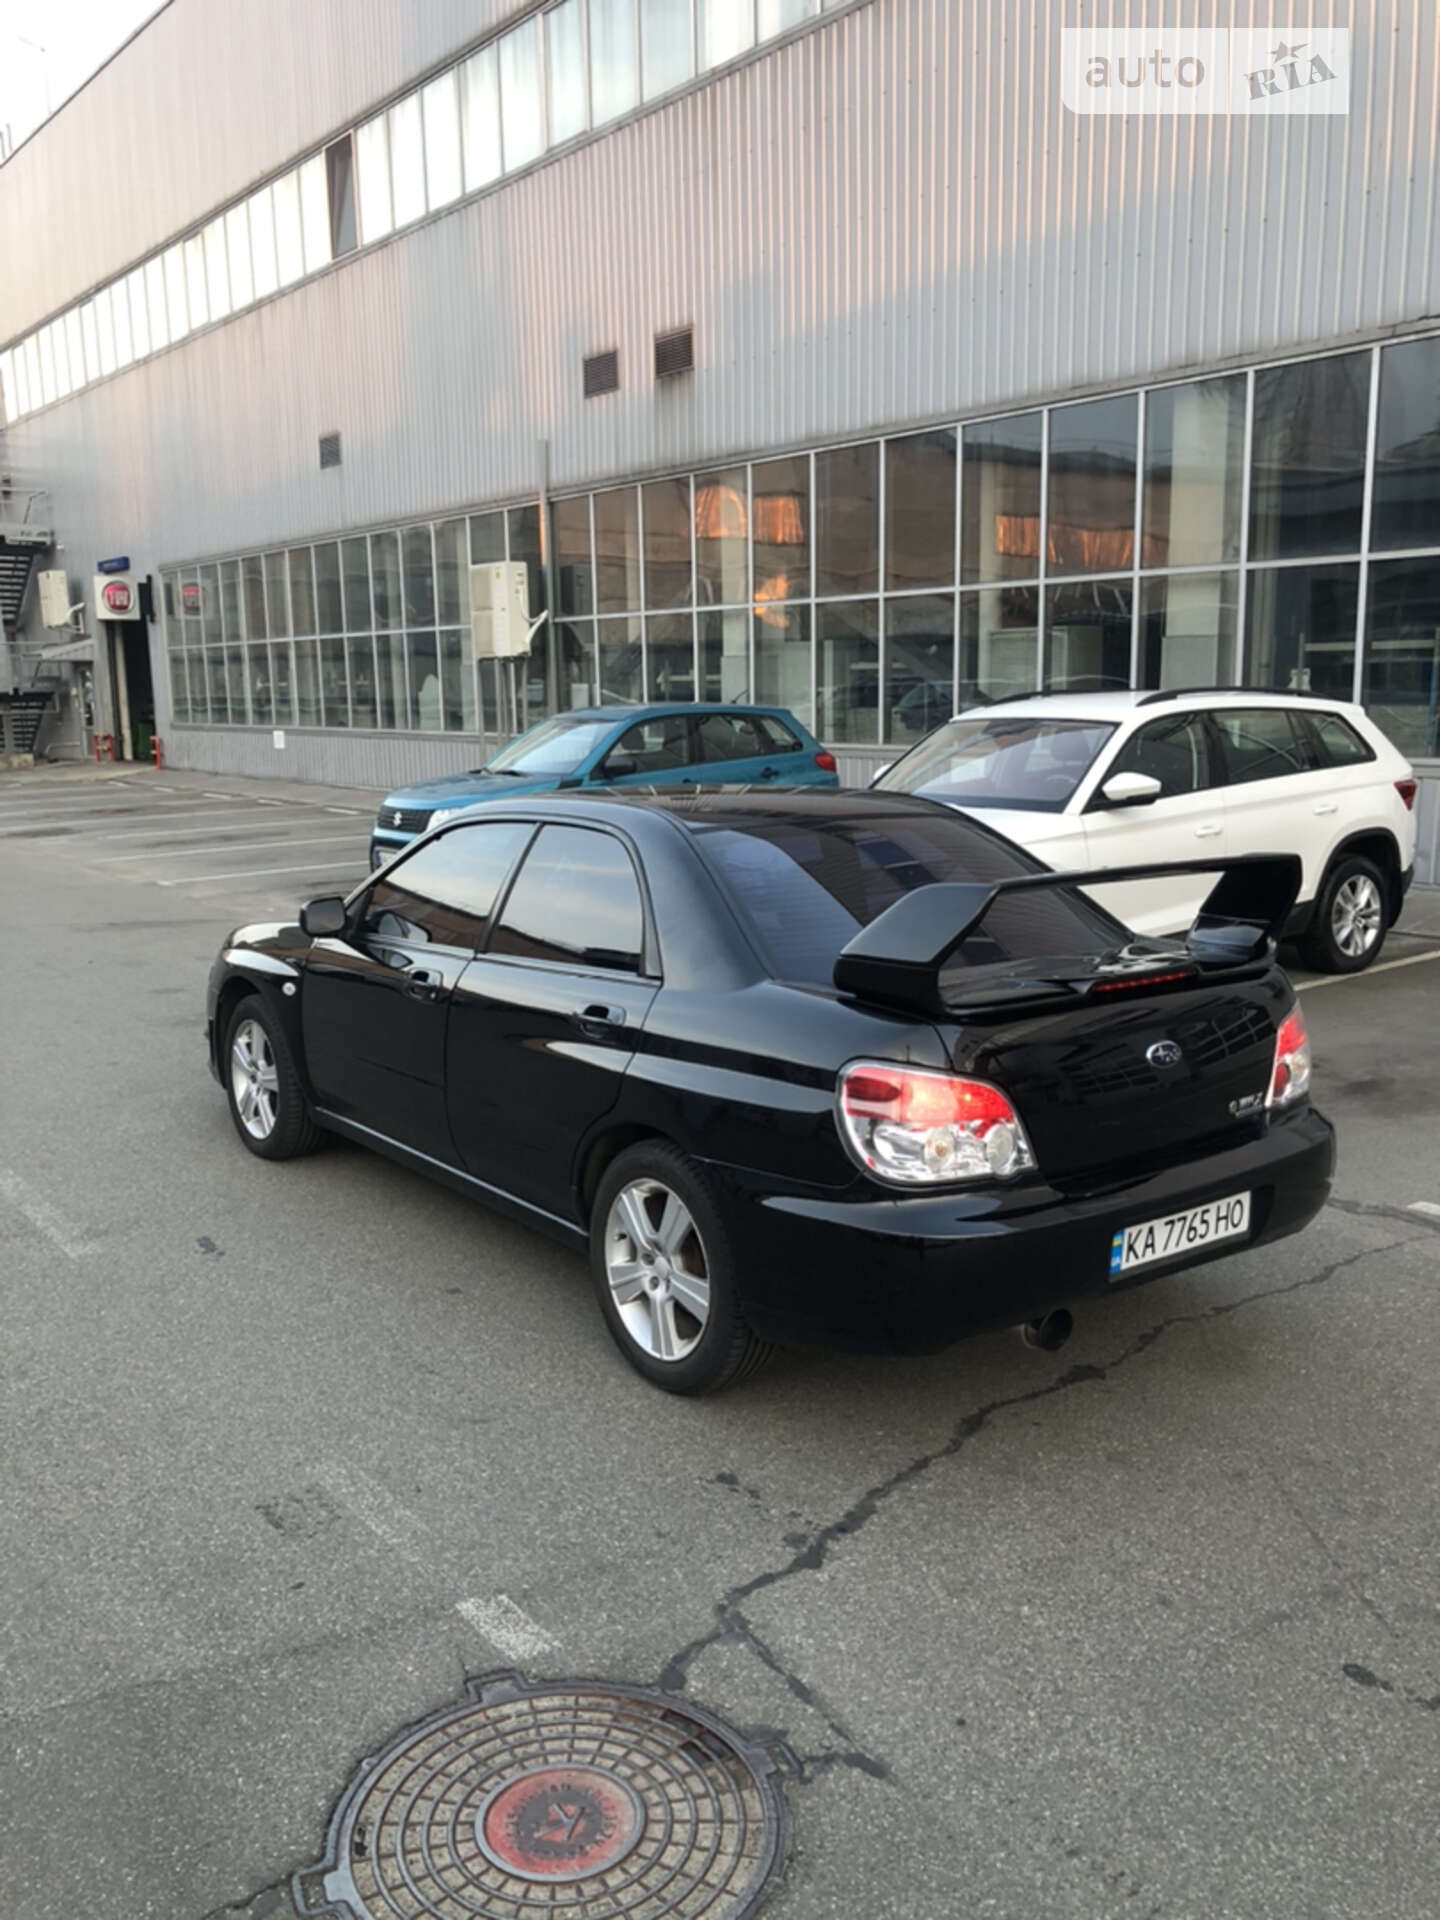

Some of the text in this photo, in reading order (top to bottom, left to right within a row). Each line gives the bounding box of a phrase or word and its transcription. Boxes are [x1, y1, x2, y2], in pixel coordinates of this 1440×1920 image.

[1125, 1199, 1244, 1263] KA 7765 HO
